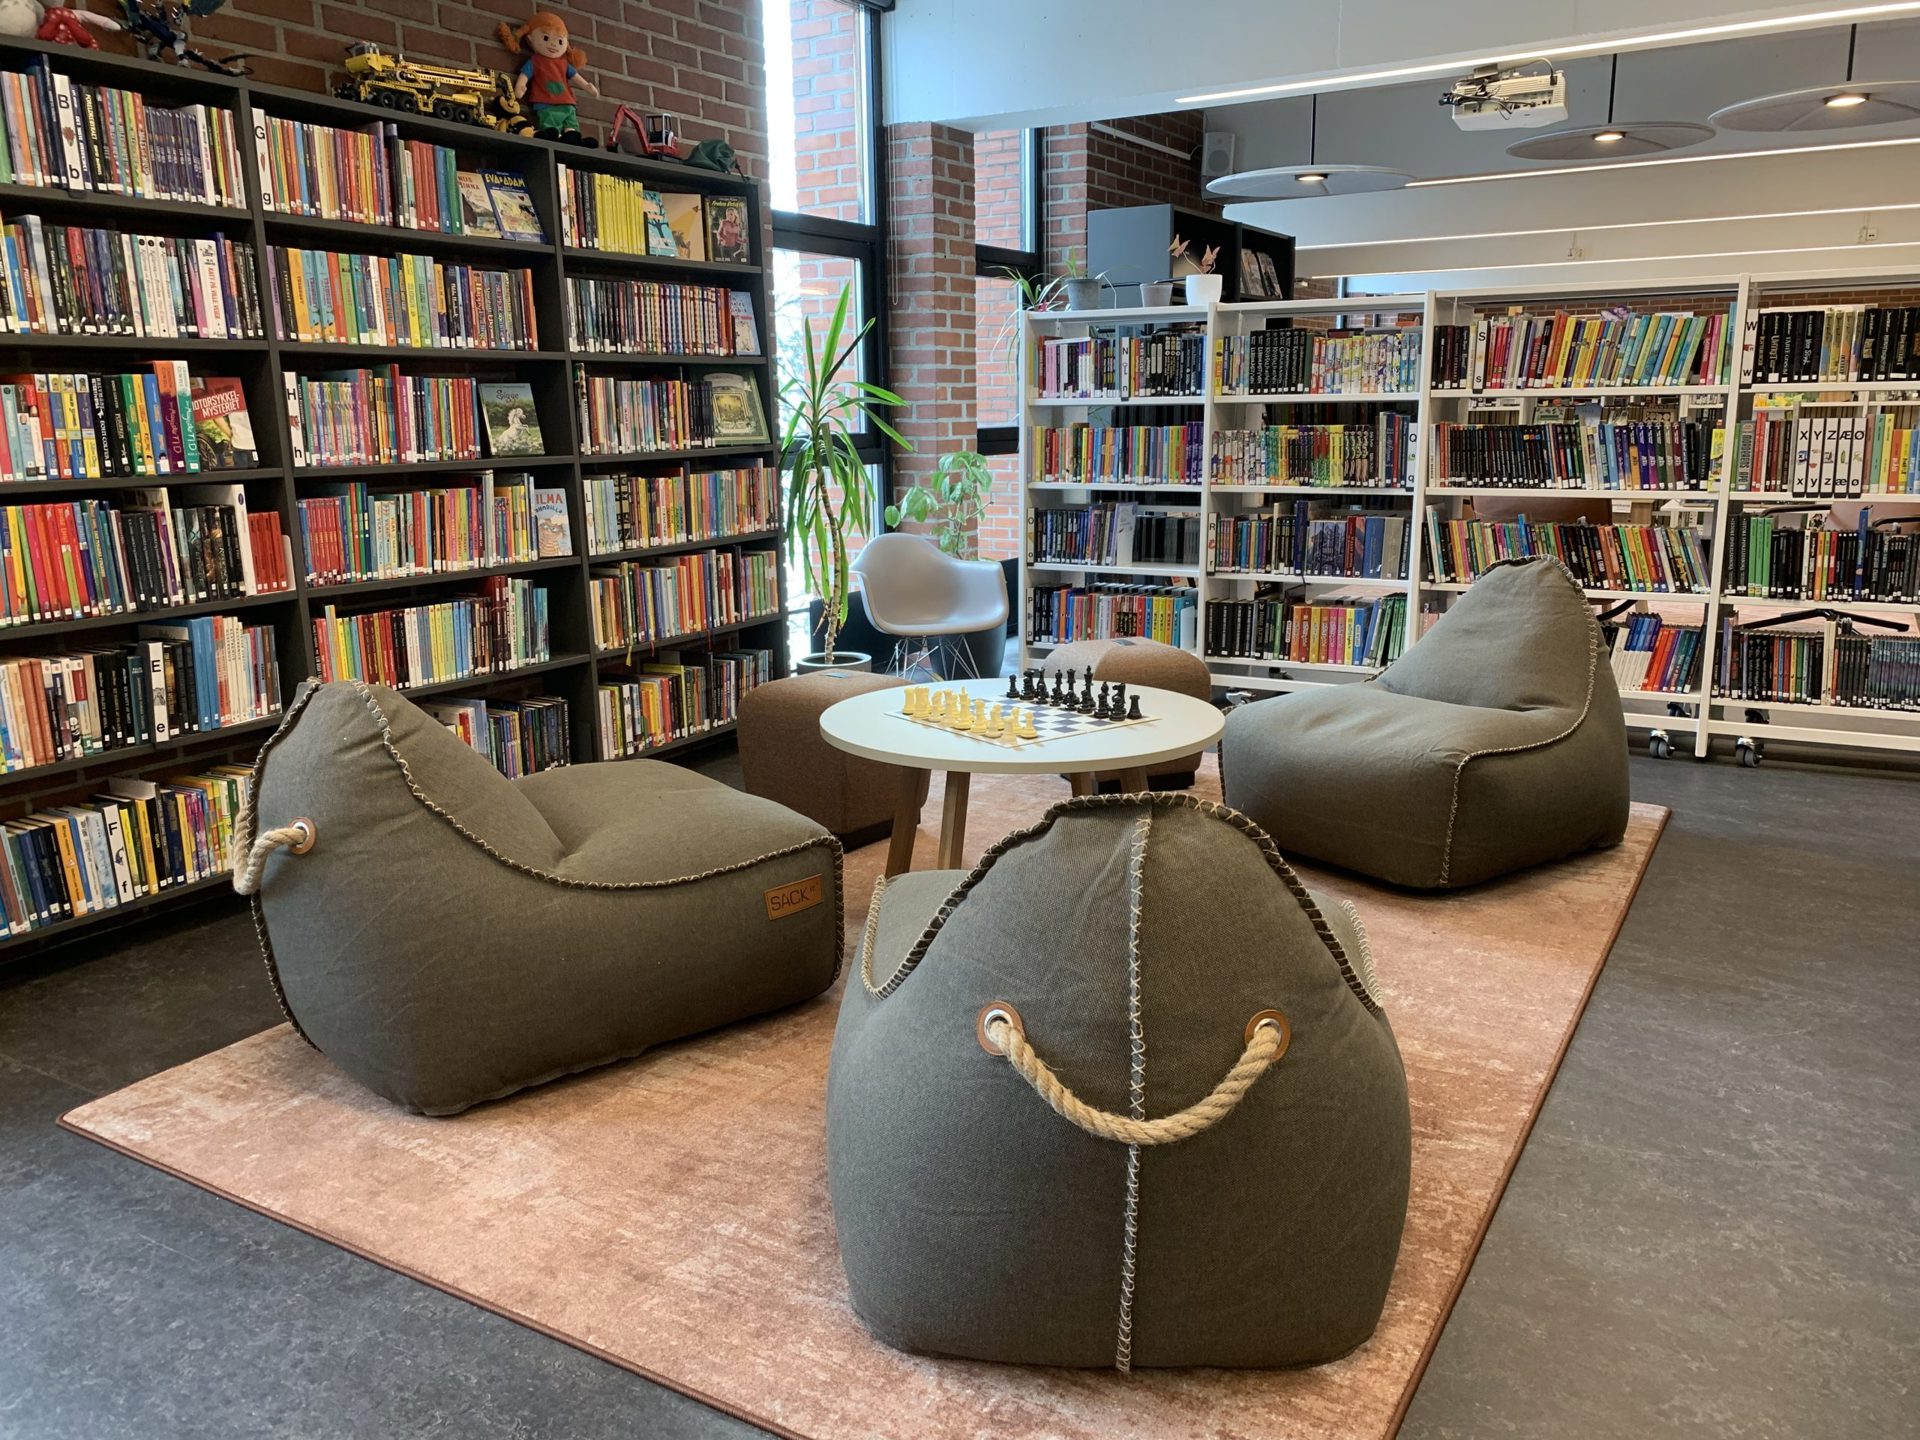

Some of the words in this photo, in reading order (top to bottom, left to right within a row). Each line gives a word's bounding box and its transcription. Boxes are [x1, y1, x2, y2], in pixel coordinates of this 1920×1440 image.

[58, 94, 70, 109] B
[254, 126, 266, 140] G
[69, 164, 80, 179] b
[262, 192, 271, 205] g
[1746, 321, 1759, 331] W
[1478, 331, 1486, 342] S
[1122, 347, 1129, 355] N
[287, 389, 296, 400] H
[202, 399, 240, 419] MYSTERIET
[1410, 433, 1417, 443] Q
[1800, 431, 1808, 440] X
[1813, 431, 1822, 440] Y
[1827, 431, 1837, 440] Z
[1839, 431, 1851, 440] Æ
[1854, 430, 1865, 440] Ø
[294, 447, 302, 458] h
[1810, 478, 1818, 487] y
[1852, 477, 1859, 486] ø
[151, 659, 161, 673] E
[156, 722, 166, 733] e
[108, 822, 118, 836] F
[121, 881, 128, 893] f
